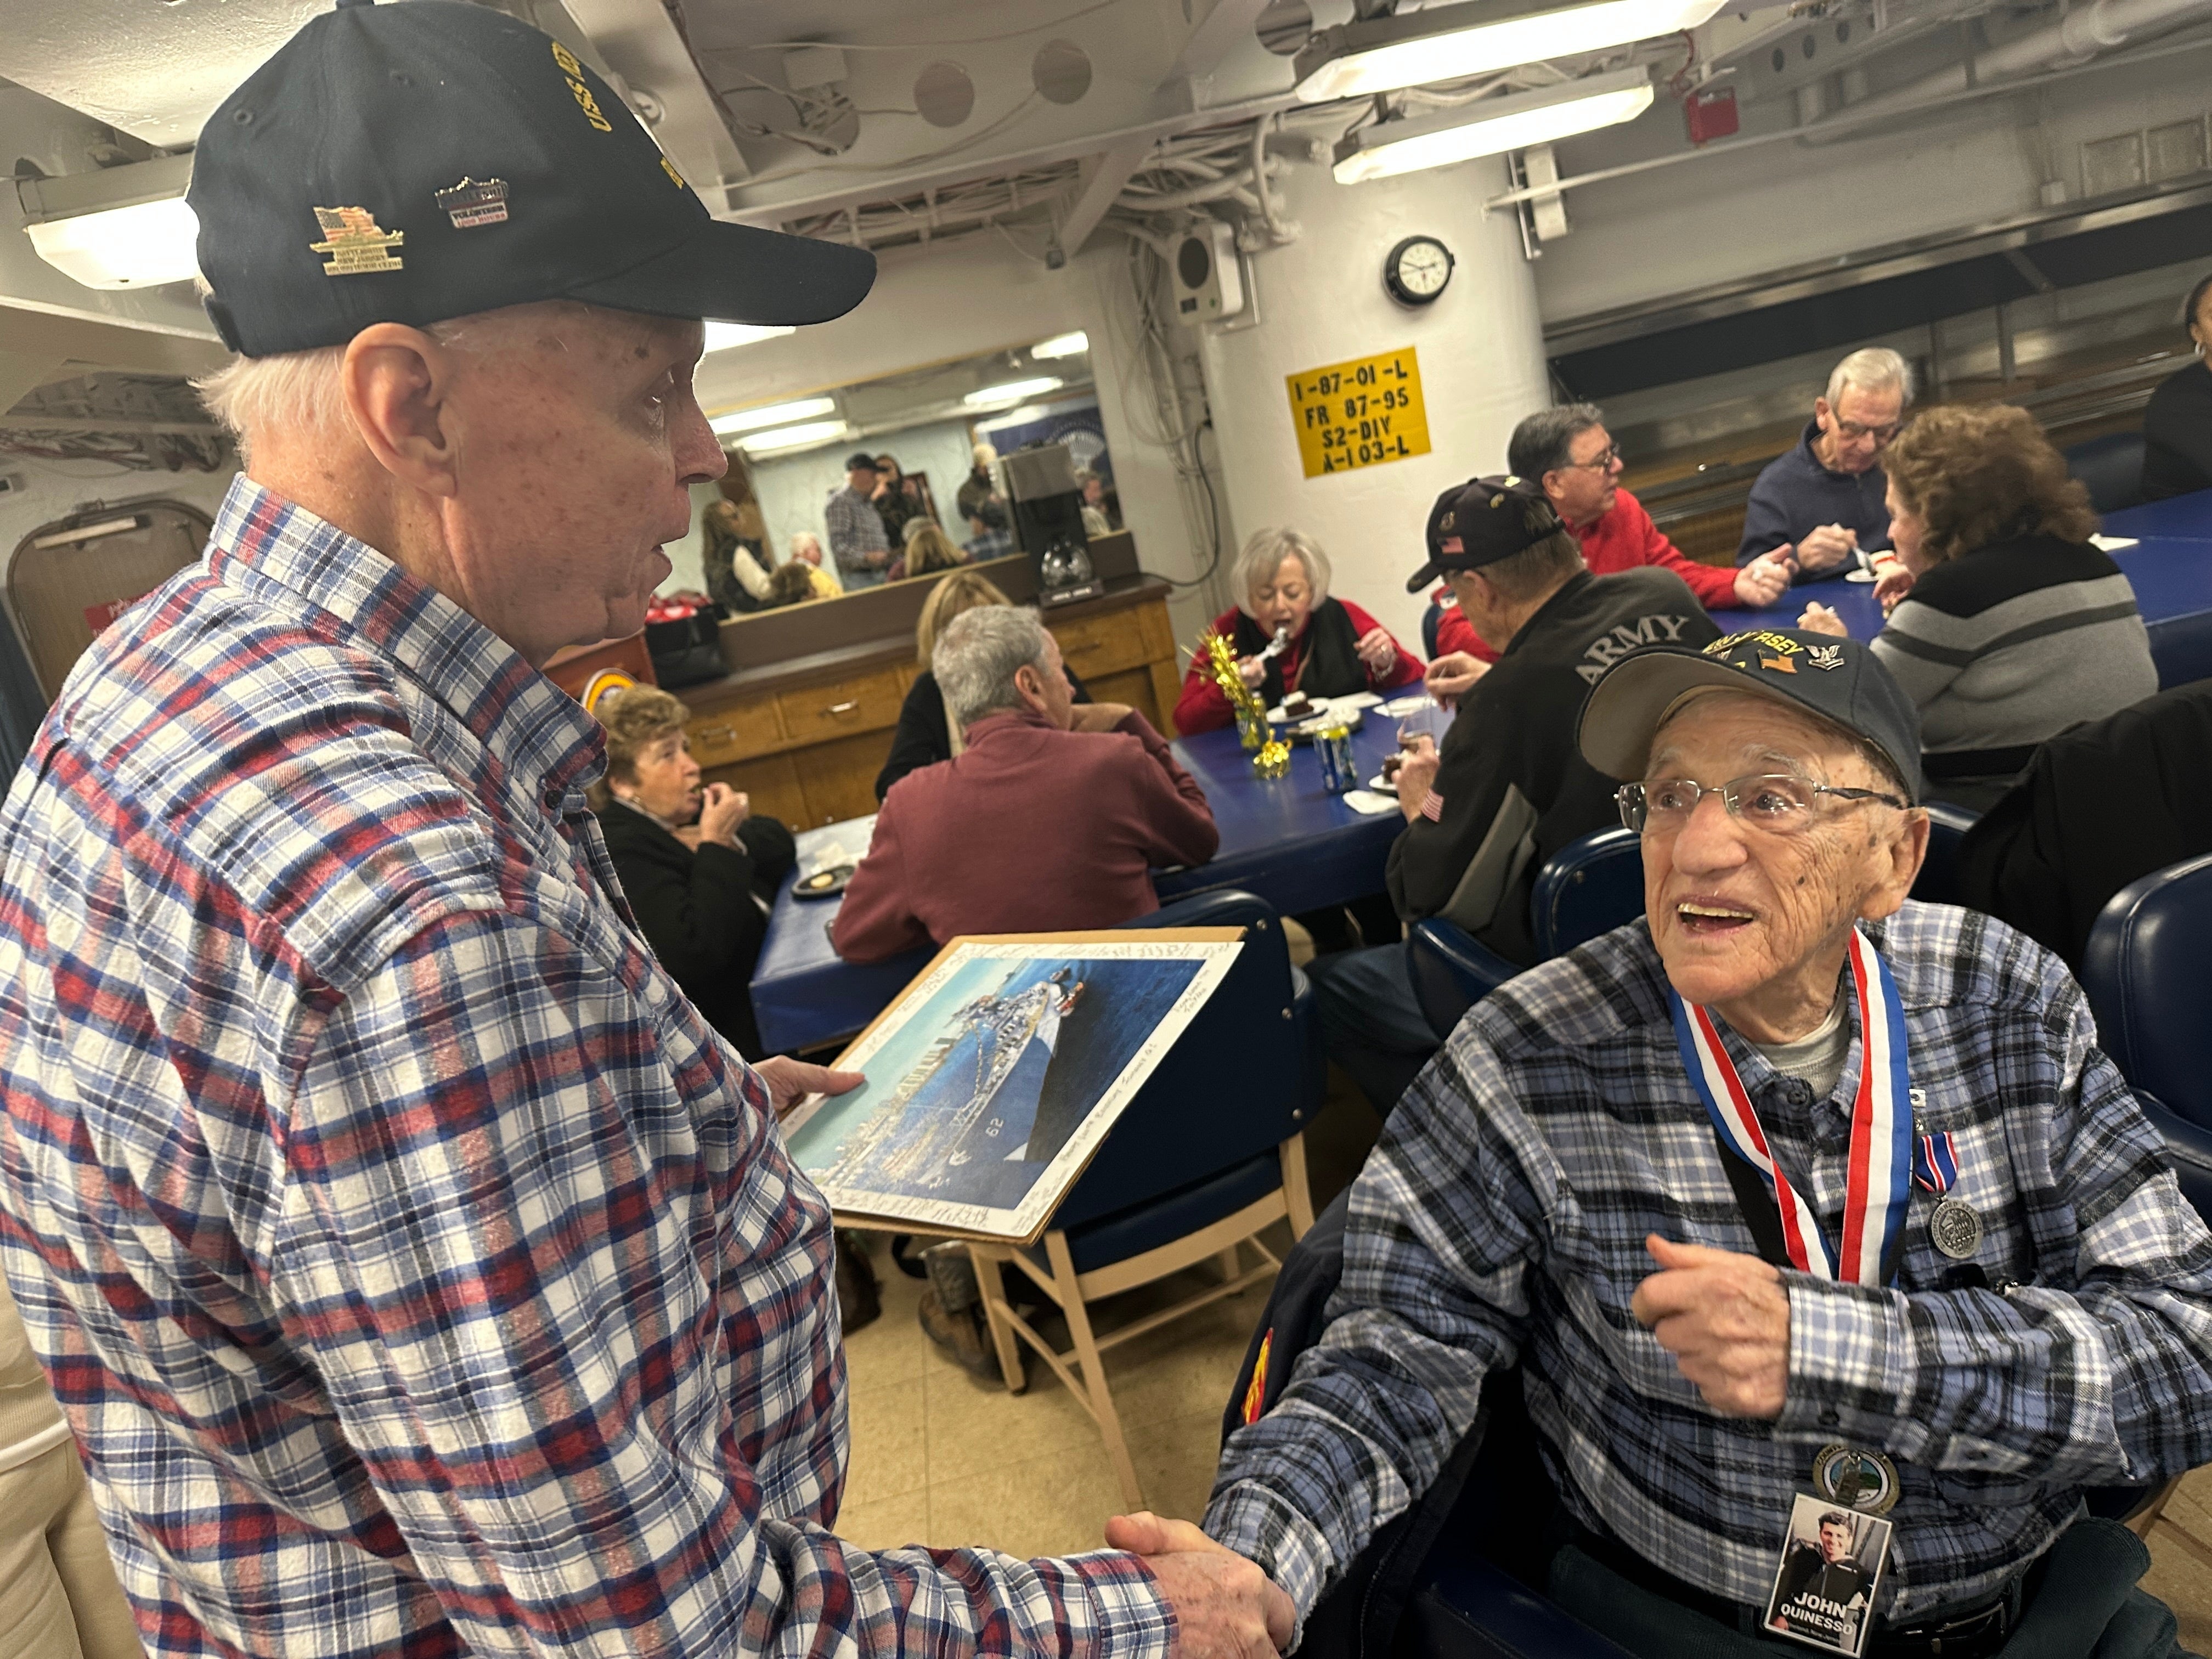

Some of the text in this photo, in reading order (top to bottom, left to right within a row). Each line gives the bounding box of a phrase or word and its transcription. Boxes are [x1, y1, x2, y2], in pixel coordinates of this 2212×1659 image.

[1304, 386, 1409, 429] FR 87-95
[1322, 415, 1390, 448] S2-DIV
[1323, 435, 1409, 473] A-103-L
[1575, 614, 1689, 686] ARMY
[985, 1118, 1004, 1138] 62
[1794, 1592, 1847, 1618] JOHN
